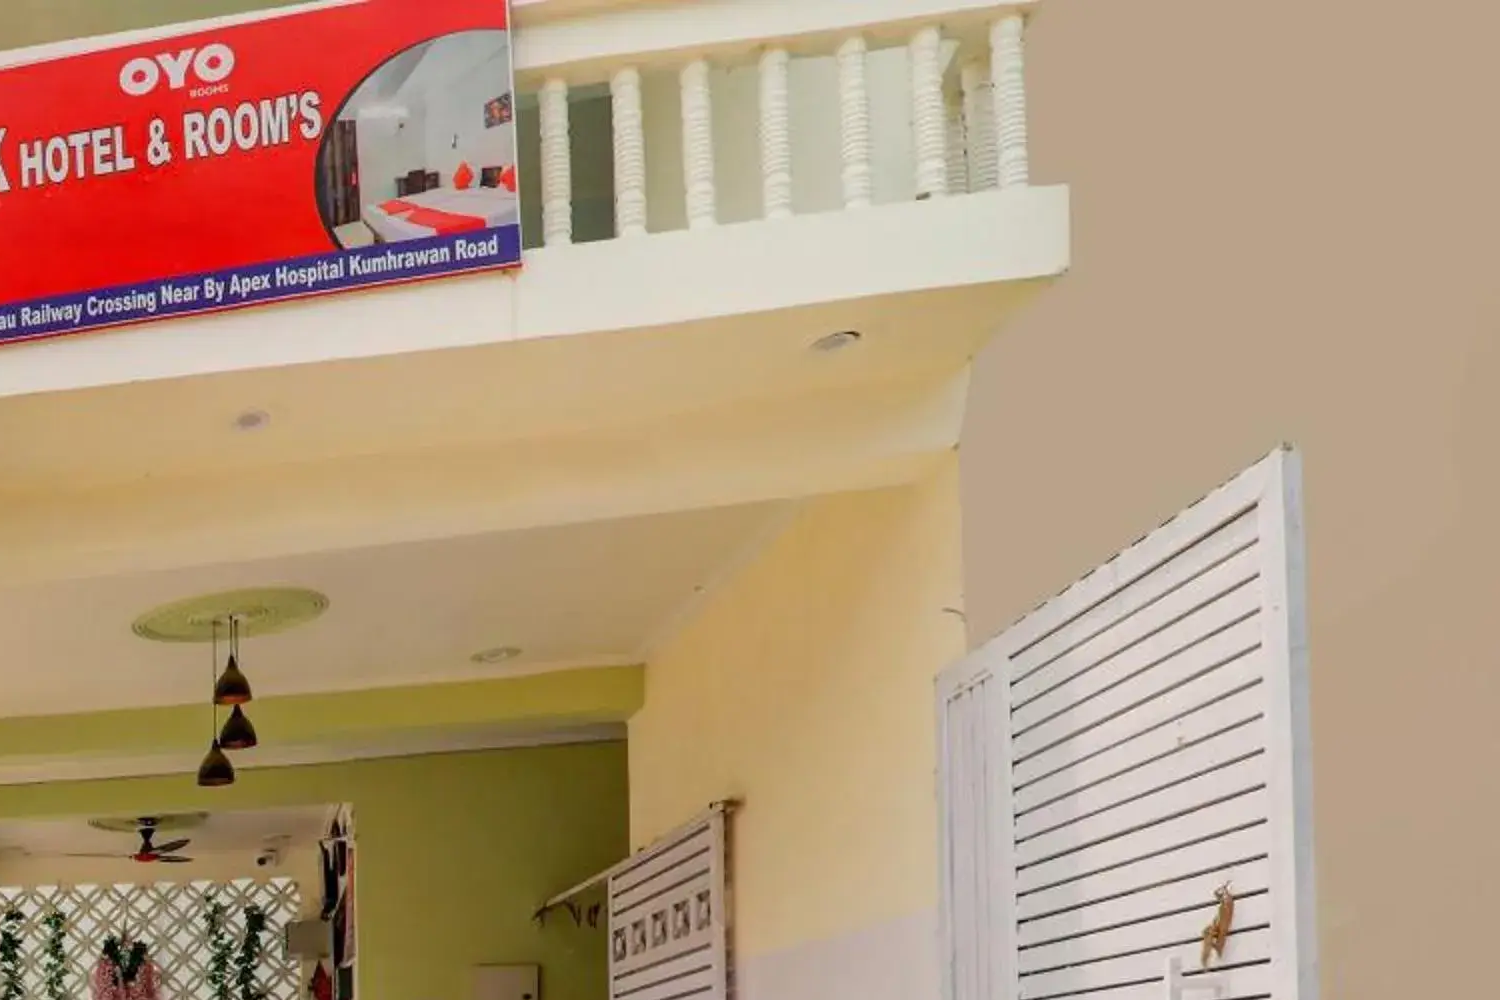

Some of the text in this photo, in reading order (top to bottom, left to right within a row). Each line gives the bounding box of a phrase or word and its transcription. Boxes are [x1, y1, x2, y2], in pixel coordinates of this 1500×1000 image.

[119, 43, 235, 96] OYO
[189, 83, 230, 98] ROOMS
[19, 126, 136, 188] HOTEL
[147, 117, 172, 166] &
[183, 91, 323, 160] ROOM'S
[21, 302, 83, 328] Railway
[87, 289, 157, 316] Crossing
[161, 282, 200, 306] Near
[204, 276, 225, 303] By
[229, 272, 271, 298] Apex
[275, 259, 345, 289] Hospital
[350, 243, 450, 277] Kumhrawan
[455, 234, 498, 261] Road
